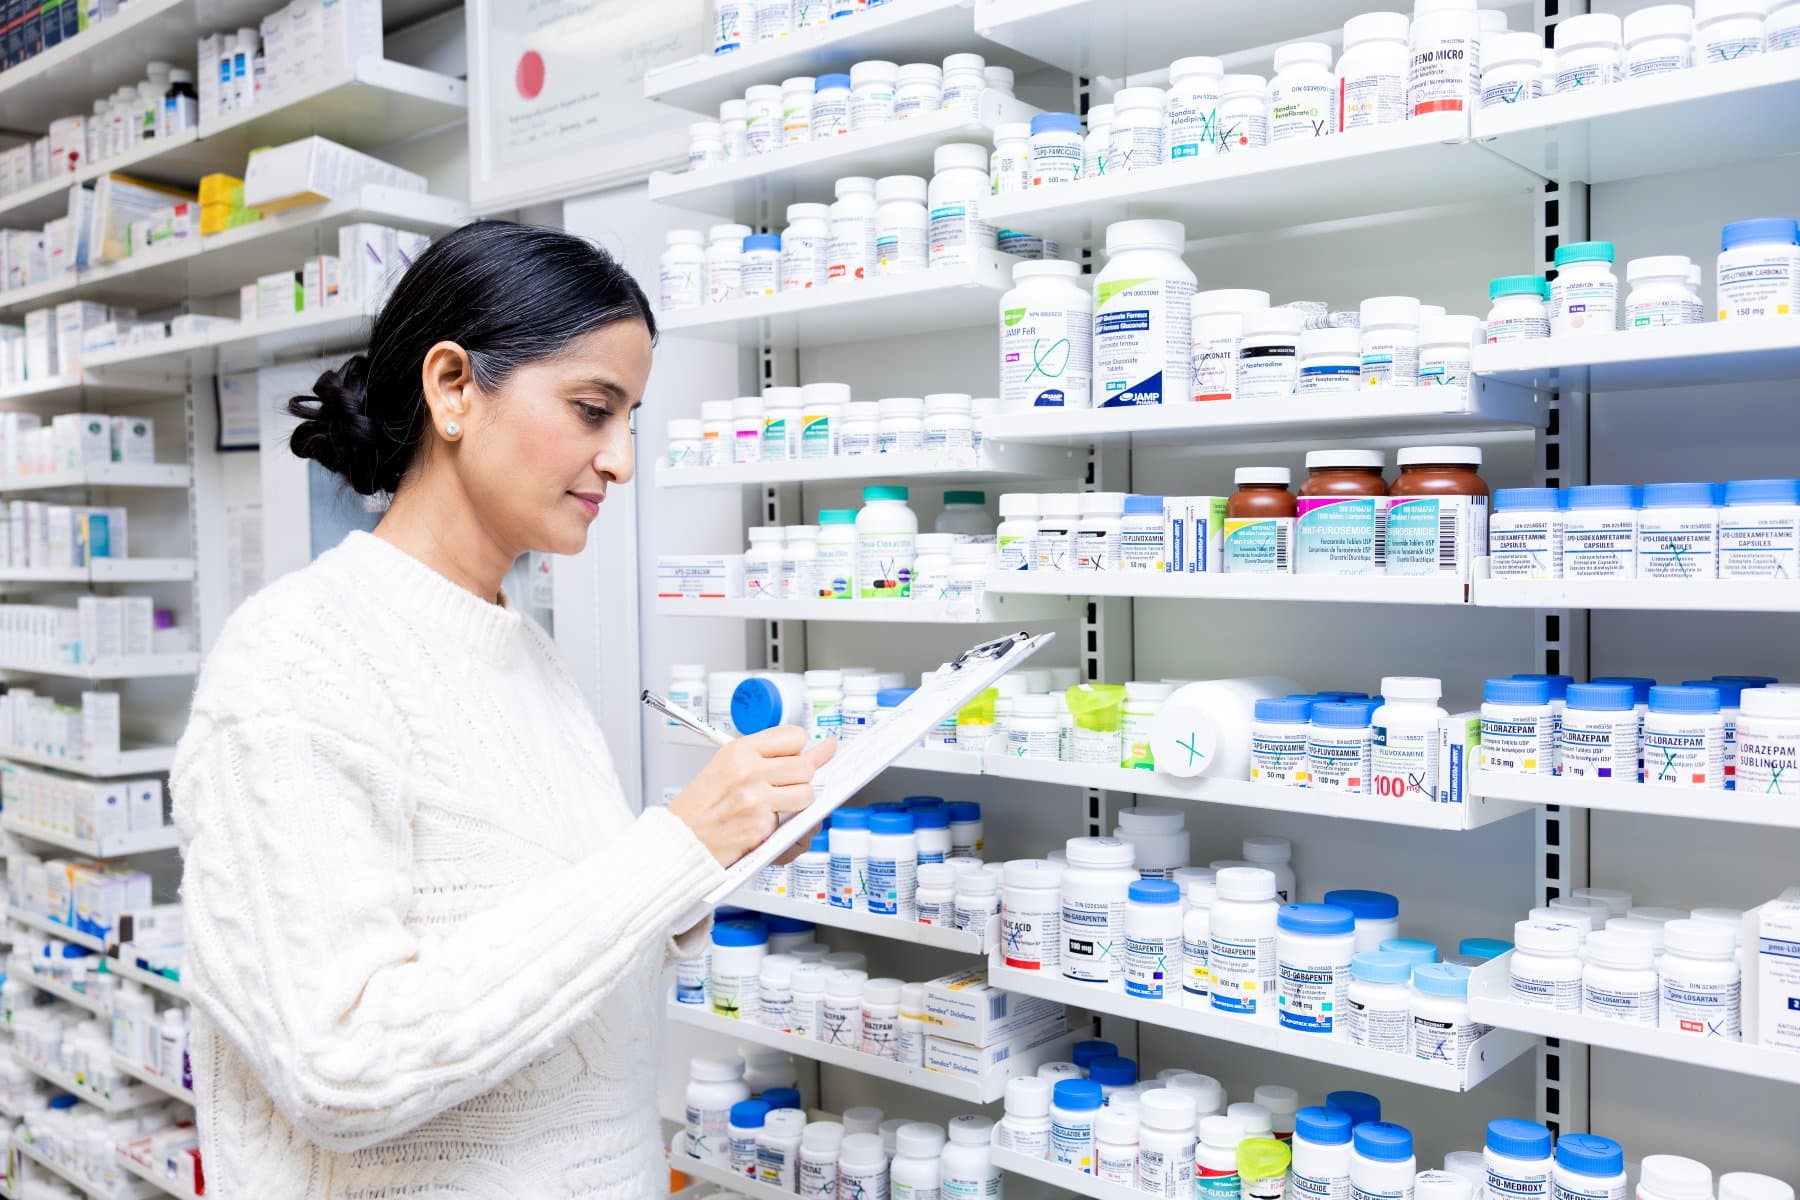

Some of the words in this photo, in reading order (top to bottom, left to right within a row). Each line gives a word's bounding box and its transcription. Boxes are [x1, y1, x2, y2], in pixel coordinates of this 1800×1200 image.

[1414, 51, 1434, 66] FENO
[1435, 49, 1465, 62] MICRO
[1048, 176, 1059, 184] 500
[1754, 268, 1789, 278] CARBONATE
[1736, 307, 1751, 317] 150
[1751, 307, 1765, 318] mg
[1131, 392, 1161, 402] JAMP
[1500, 541, 1527, 549] CAPSULES
[1583, 541, 1615, 549] CAPSULES
[1660, 543, 1693, 552] CAPSULES
[1253, 742, 1306, 753] APO-FLUVOXAMINE
[1309, 746, 1360, 757] APO-FLUVOXAMINE
[1379, 748, 1425, 758] FLUVOXAMINE
[1739, 743, 1796, 757] LORAZEPAM
[1490, 757, 1502, 766] 0.5
[1502, 759, 1515, 769] mg
[1739, 755, 1799, 772] SUBLINGUAL
[1266, 771, 1275, 779] 50
[1275, 772, 1286, 781] mg
[1573, 768, 1585, 778] mg
[1329, 777, 1340, 786] mg
[1664, 775, 1677, 784] mg
[1374, 774, 1405, 799] 100
[1406, 785, 1421, 794] mg
[1014, 922, 1032, 933] ACID
[1070, 941, 1081, 951] 100
[1081, 943, 1093, 955] mg
[1279, 968, 1334, 983] APO-GABAPENTIN
[1229, 979, 1240, 990] mg
[1669, 992, 1719, 1004] pms-LOSARTAN
[1303, 1002, 1314, 1011] mg
[949, 1009, 978, 1023] Diclofenac
[1486, 1175, 1543, 1192] APO-MEDROXY
